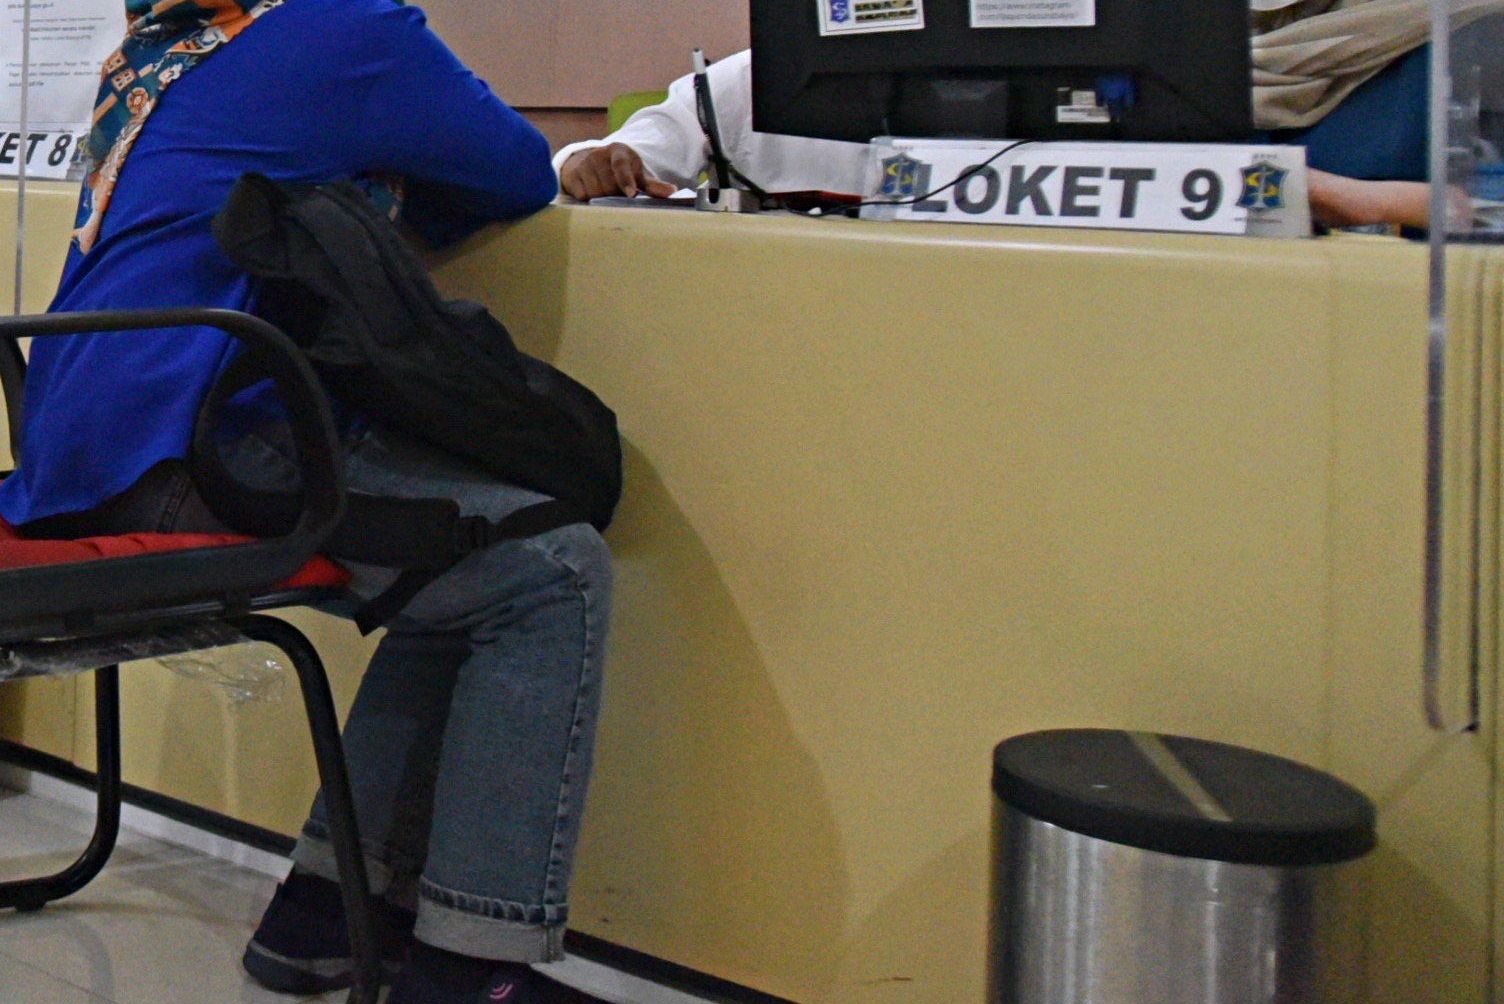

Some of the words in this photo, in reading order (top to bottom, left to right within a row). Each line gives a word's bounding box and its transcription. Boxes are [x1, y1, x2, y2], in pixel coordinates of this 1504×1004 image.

[48, 133, 72, 167] 8
[911, 162, 1157, 219] LOKET
[1180, 168, 1223, 221] 9
